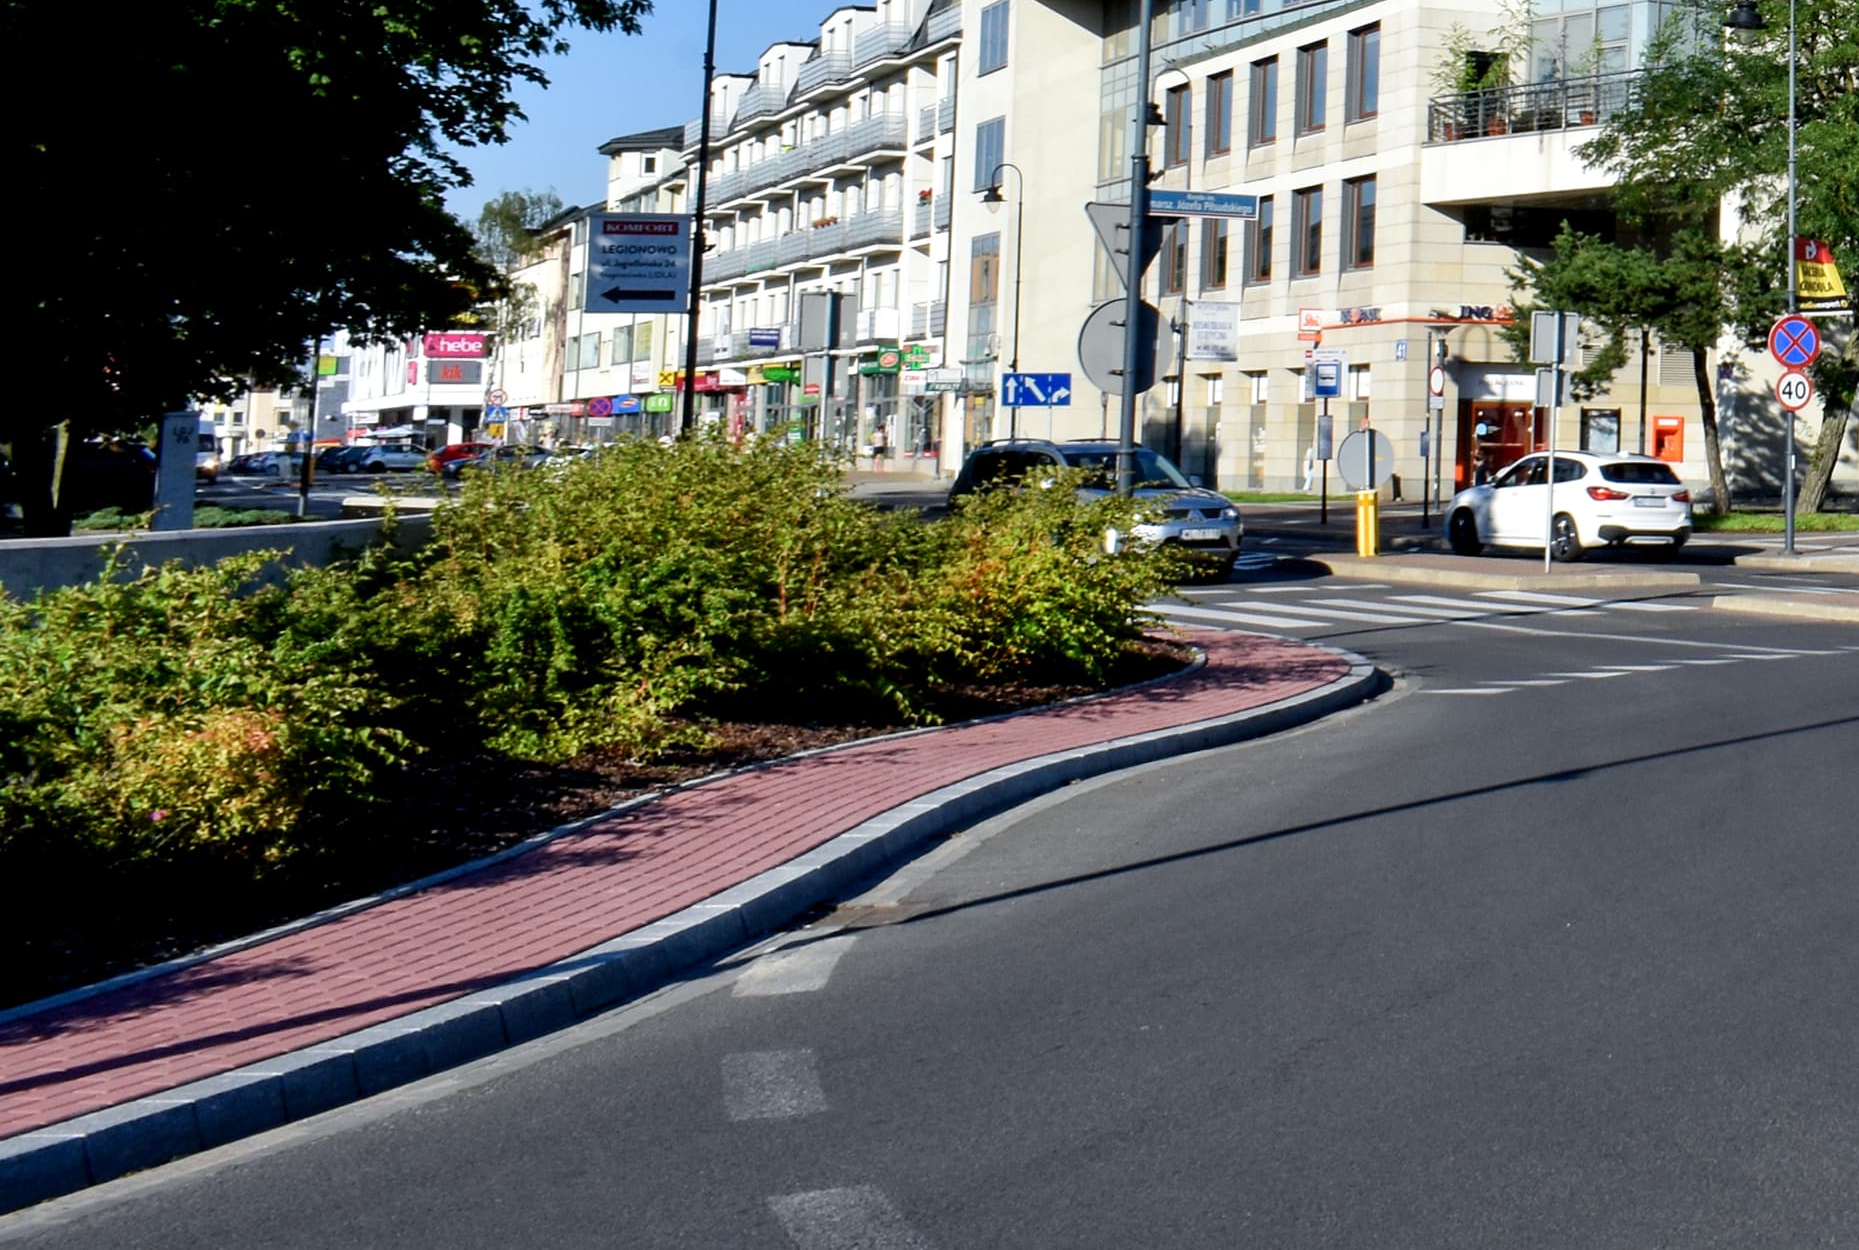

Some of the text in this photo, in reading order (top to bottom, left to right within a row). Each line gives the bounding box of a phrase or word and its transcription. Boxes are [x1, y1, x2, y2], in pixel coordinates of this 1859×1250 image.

[605, 222, 674, 232] KOMFORT
[601, 244, 677, 255] LEGIONOWO
[1459, 305, 1493, 319] ING
[439, 337, 482, 352] hebe
[1781, 380, 1807, 400] 40
